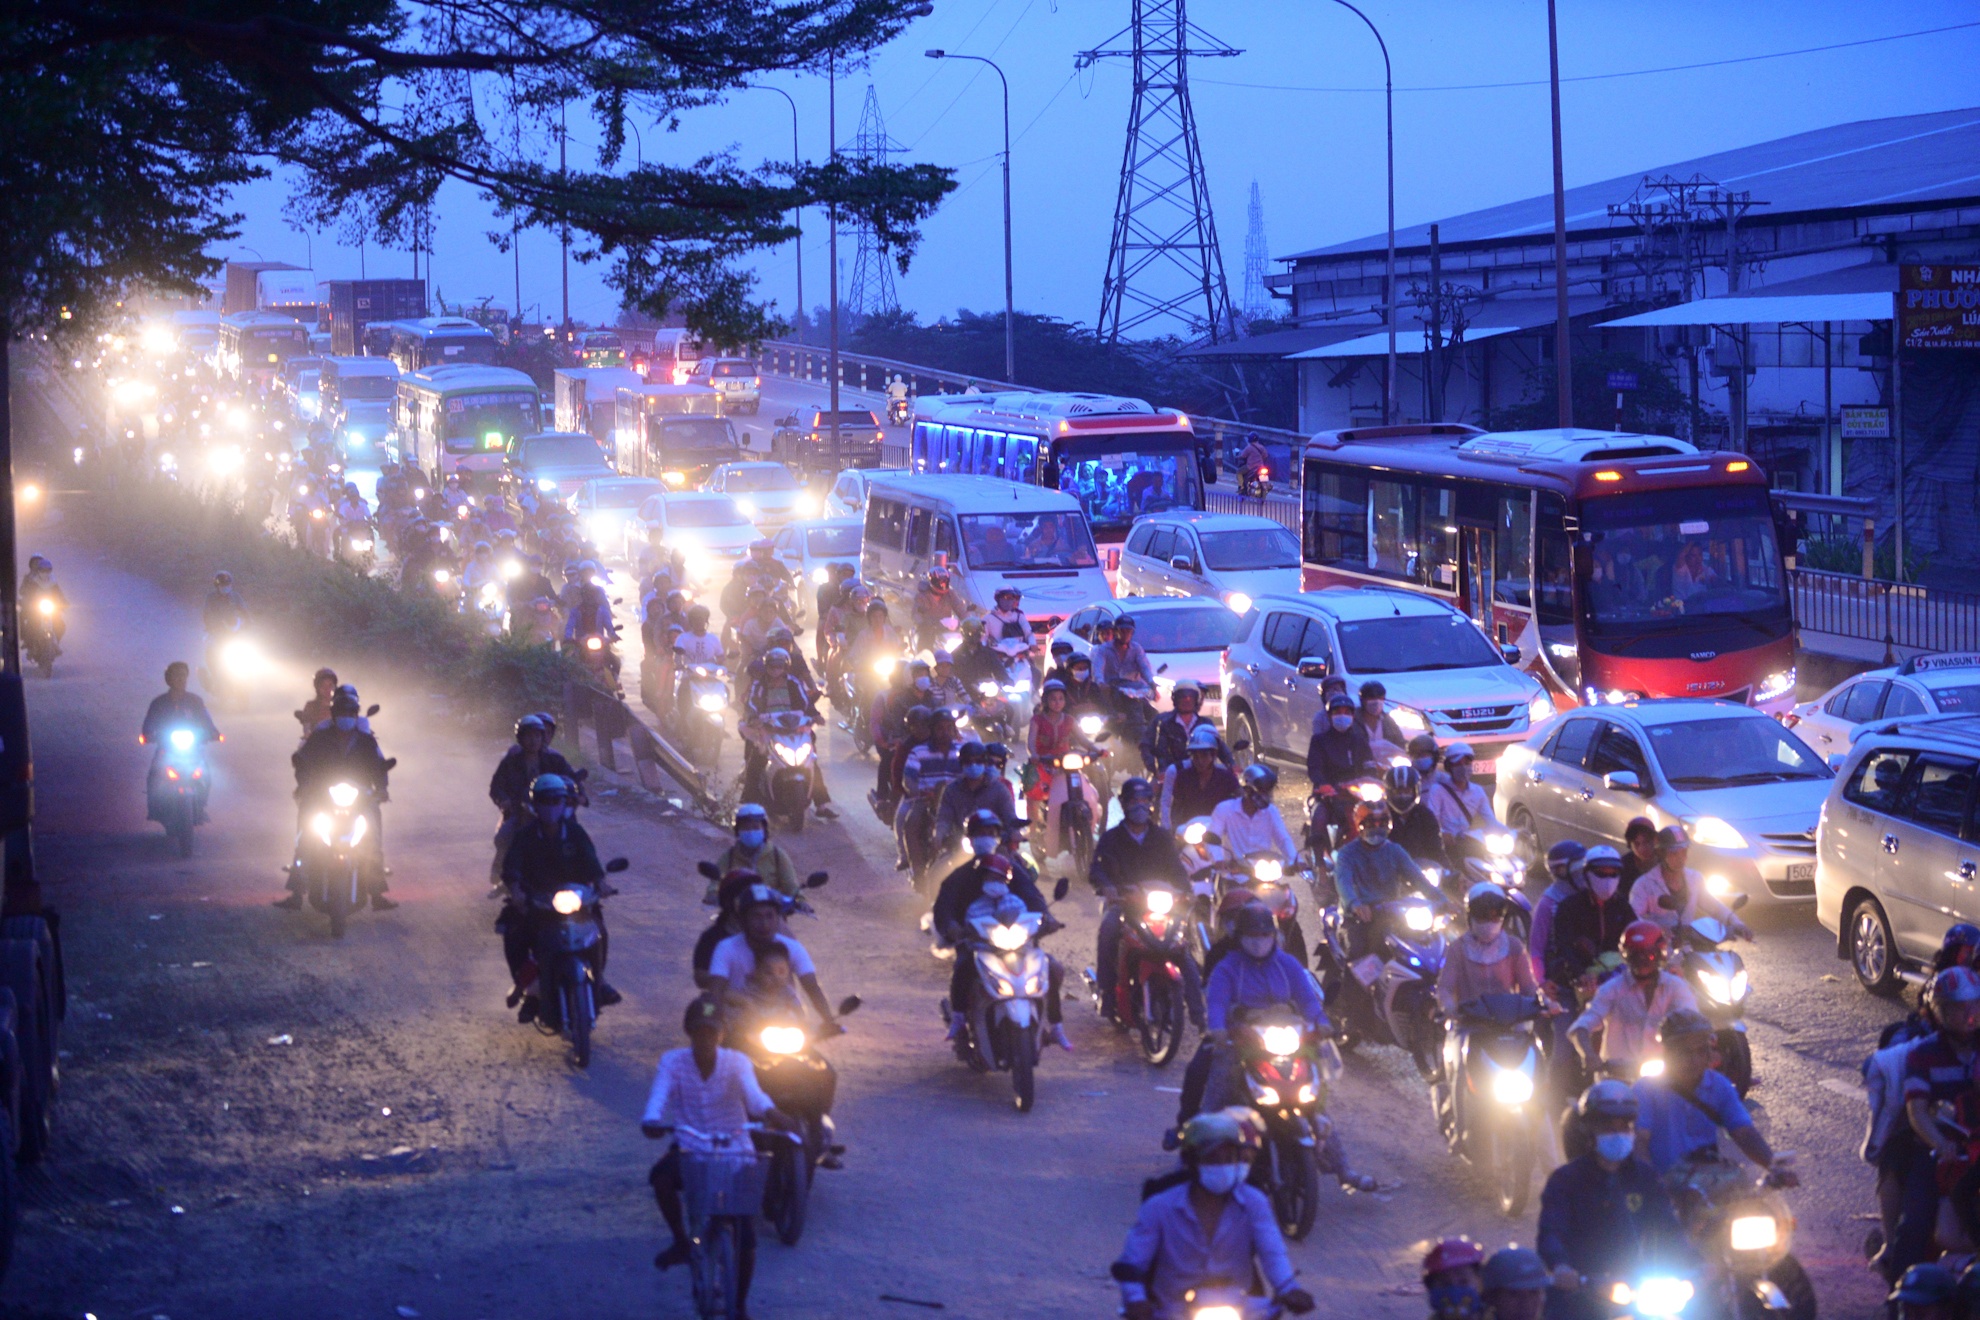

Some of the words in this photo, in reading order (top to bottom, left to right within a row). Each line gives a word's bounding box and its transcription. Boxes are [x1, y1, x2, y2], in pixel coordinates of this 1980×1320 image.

[1905, 284, 1980, 309] PHƯỚ
[1905, 338, 1923, 348] C1/2
[1690, 651, 1716, 660] SAMCO
[1931, 656, 1972, 668] VINASUN
[1686, 680, 1726, 692] ISUZU
[1461, 707, 1496, 718] ISUZU
